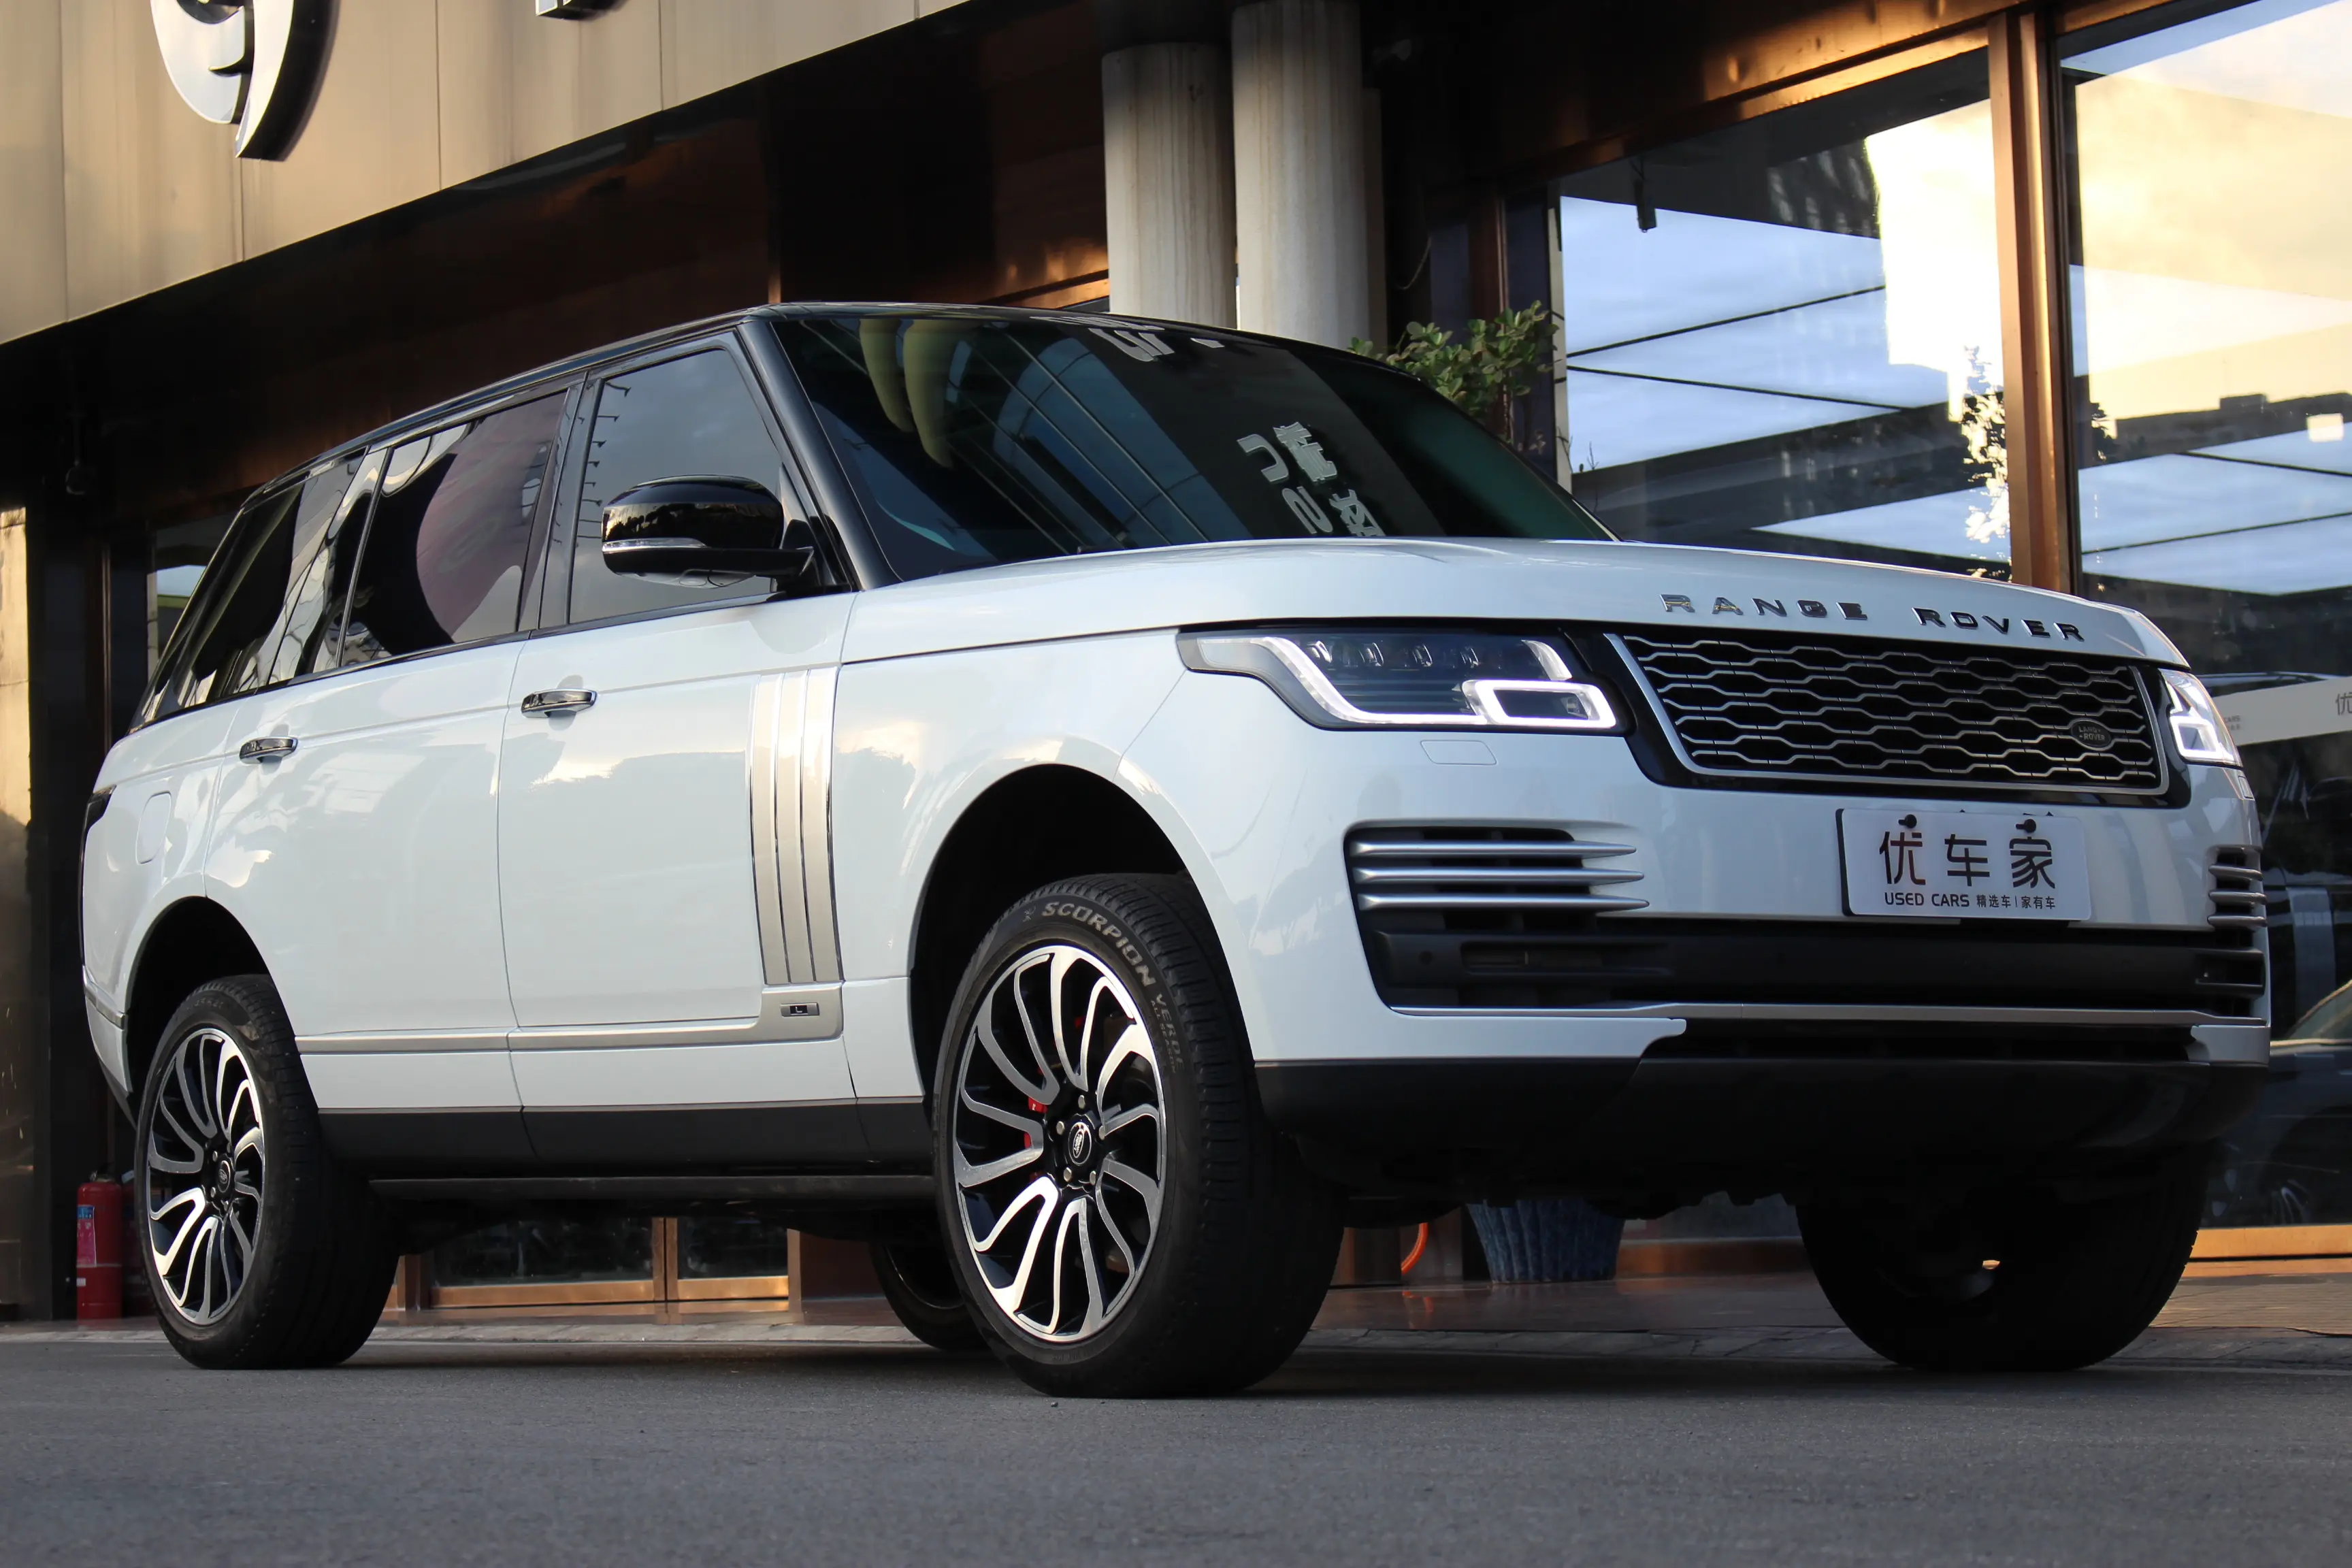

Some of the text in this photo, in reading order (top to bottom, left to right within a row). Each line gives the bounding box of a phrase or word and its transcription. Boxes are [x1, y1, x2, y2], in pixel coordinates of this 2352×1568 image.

[1659, 594, 2085, 641] RANGE ROVER
[1879, 831, 2055, 889] 优车家
[1884, 892, 1925, 906] USED
[1931, 894, 1970, 907] CARS
[1041, 902, 1185, 1071] SCORPION VERDE
